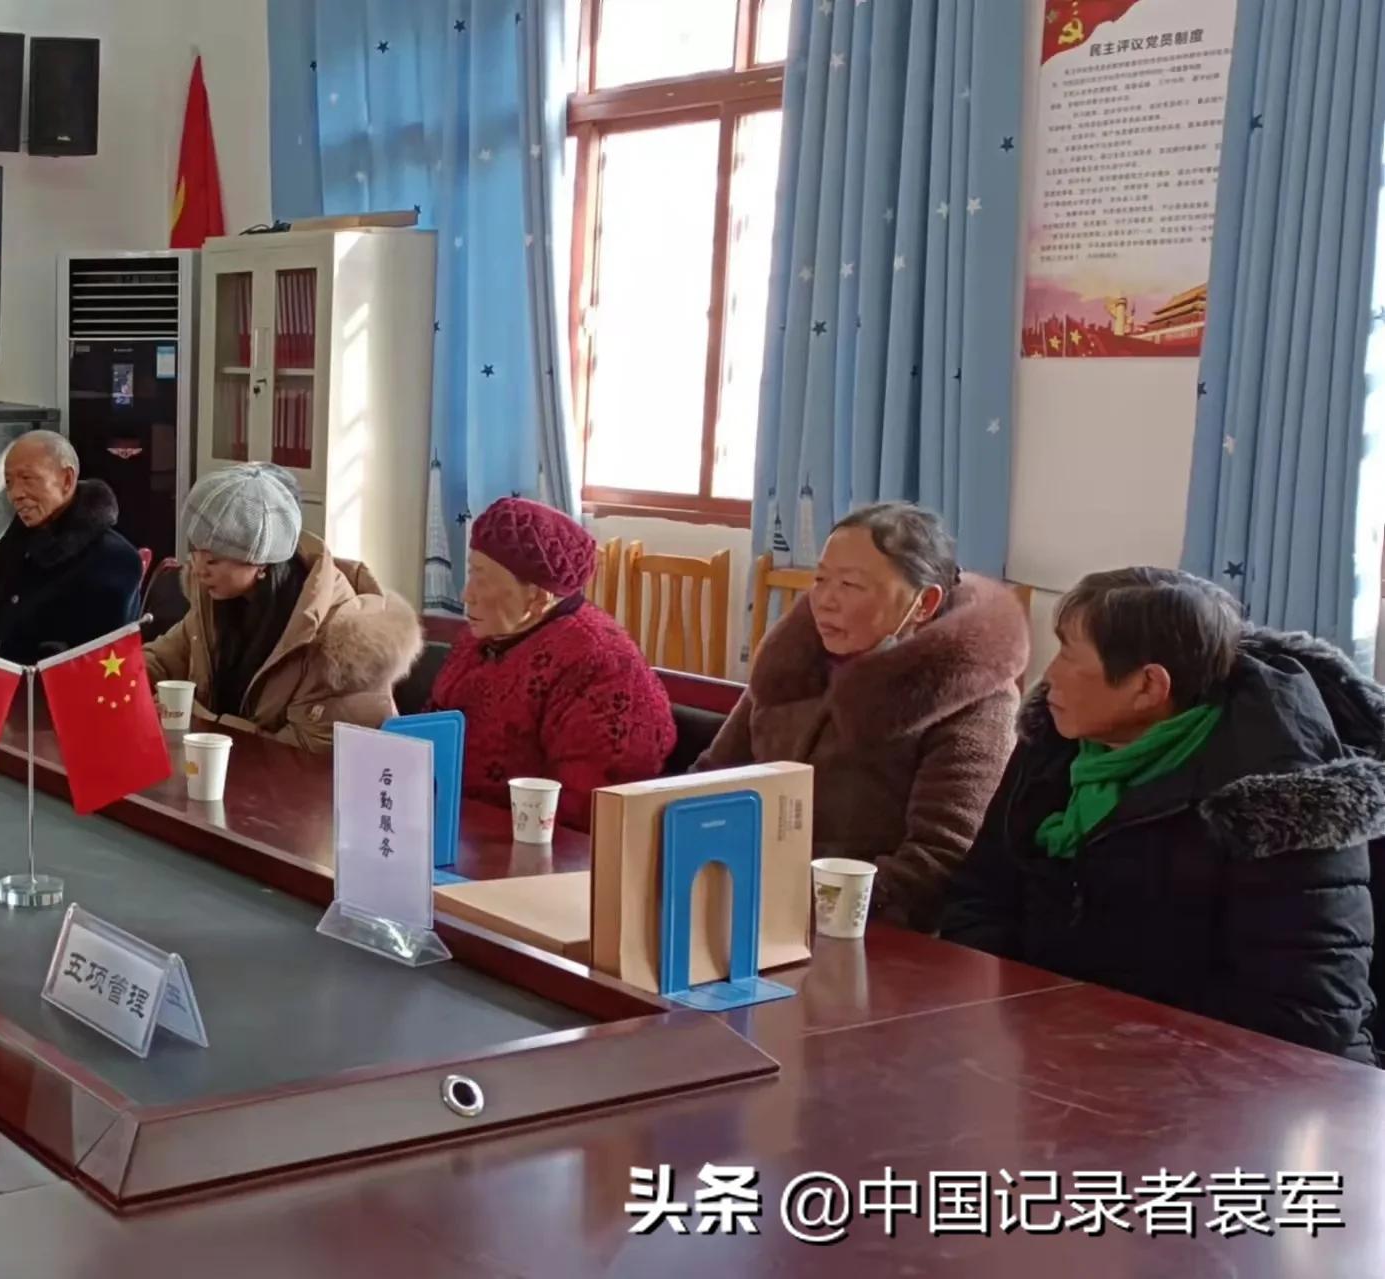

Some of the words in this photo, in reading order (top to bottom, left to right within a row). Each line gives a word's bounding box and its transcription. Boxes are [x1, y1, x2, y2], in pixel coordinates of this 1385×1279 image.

[1089, 29, 1205, 57] 民主评议党员制度
[377, 767, 396, 858] 后勤服务
[63, 951, 151, 1020] 五项管理
